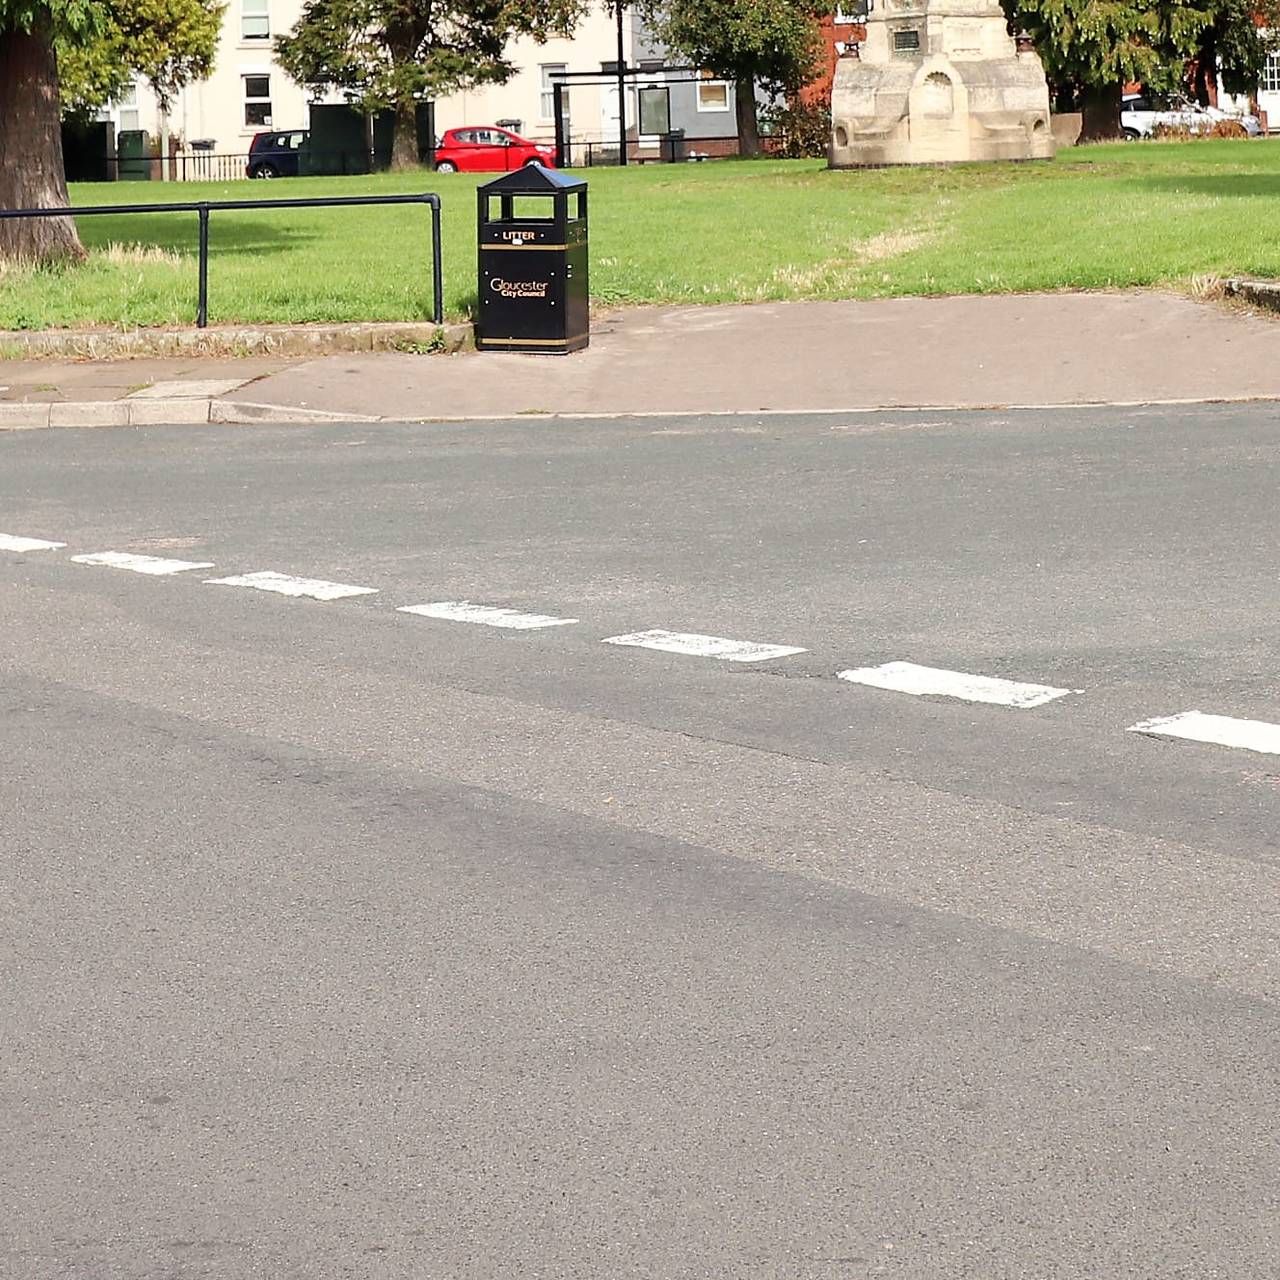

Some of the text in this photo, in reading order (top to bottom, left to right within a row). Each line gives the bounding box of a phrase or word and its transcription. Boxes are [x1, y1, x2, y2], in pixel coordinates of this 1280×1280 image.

[502, 231, 535, 240] LITTER
[490, 278, 548, 291] Gloucester
[501, 289, 546, 298] City Council
